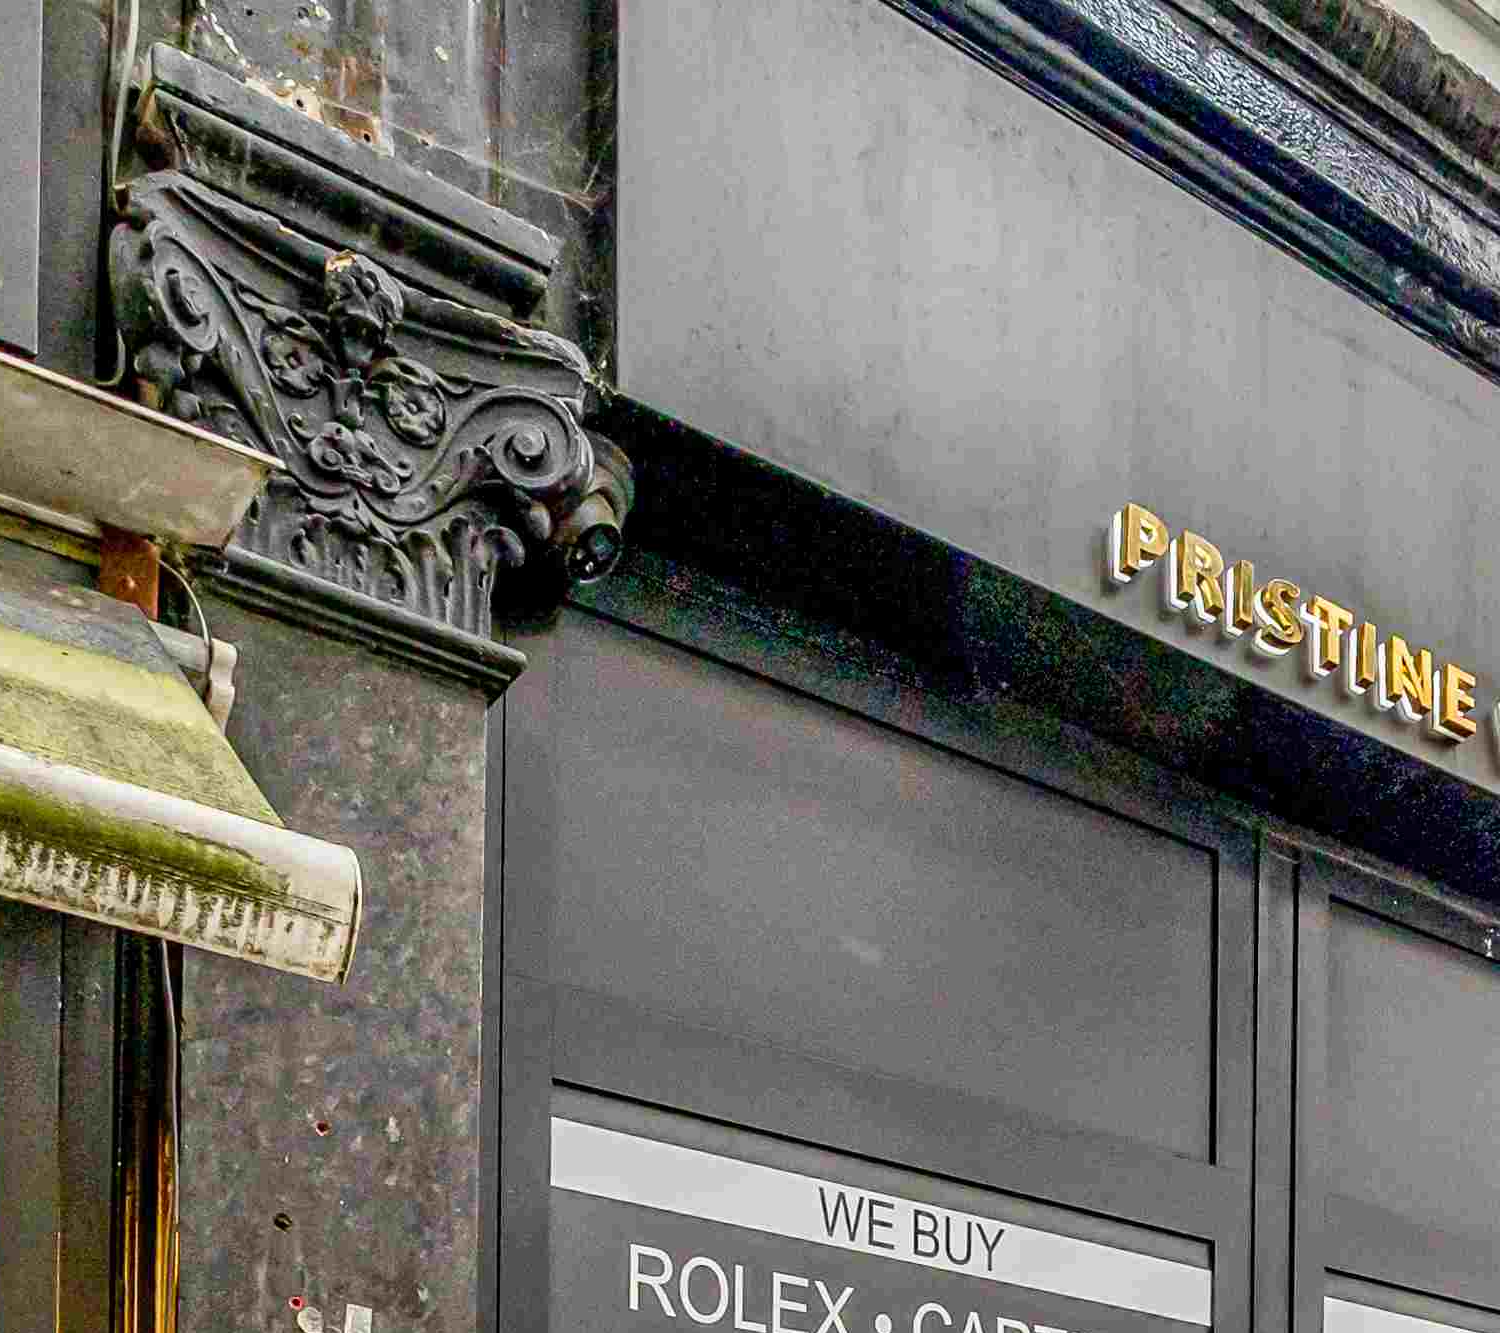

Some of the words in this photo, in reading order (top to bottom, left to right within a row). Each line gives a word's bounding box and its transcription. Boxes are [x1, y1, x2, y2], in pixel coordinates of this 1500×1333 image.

[1111, 502, 1478, 744] PRISTINE
[818, 1186, 895, 1251] WE
[912, 1208, 1005, 1272] BUY
